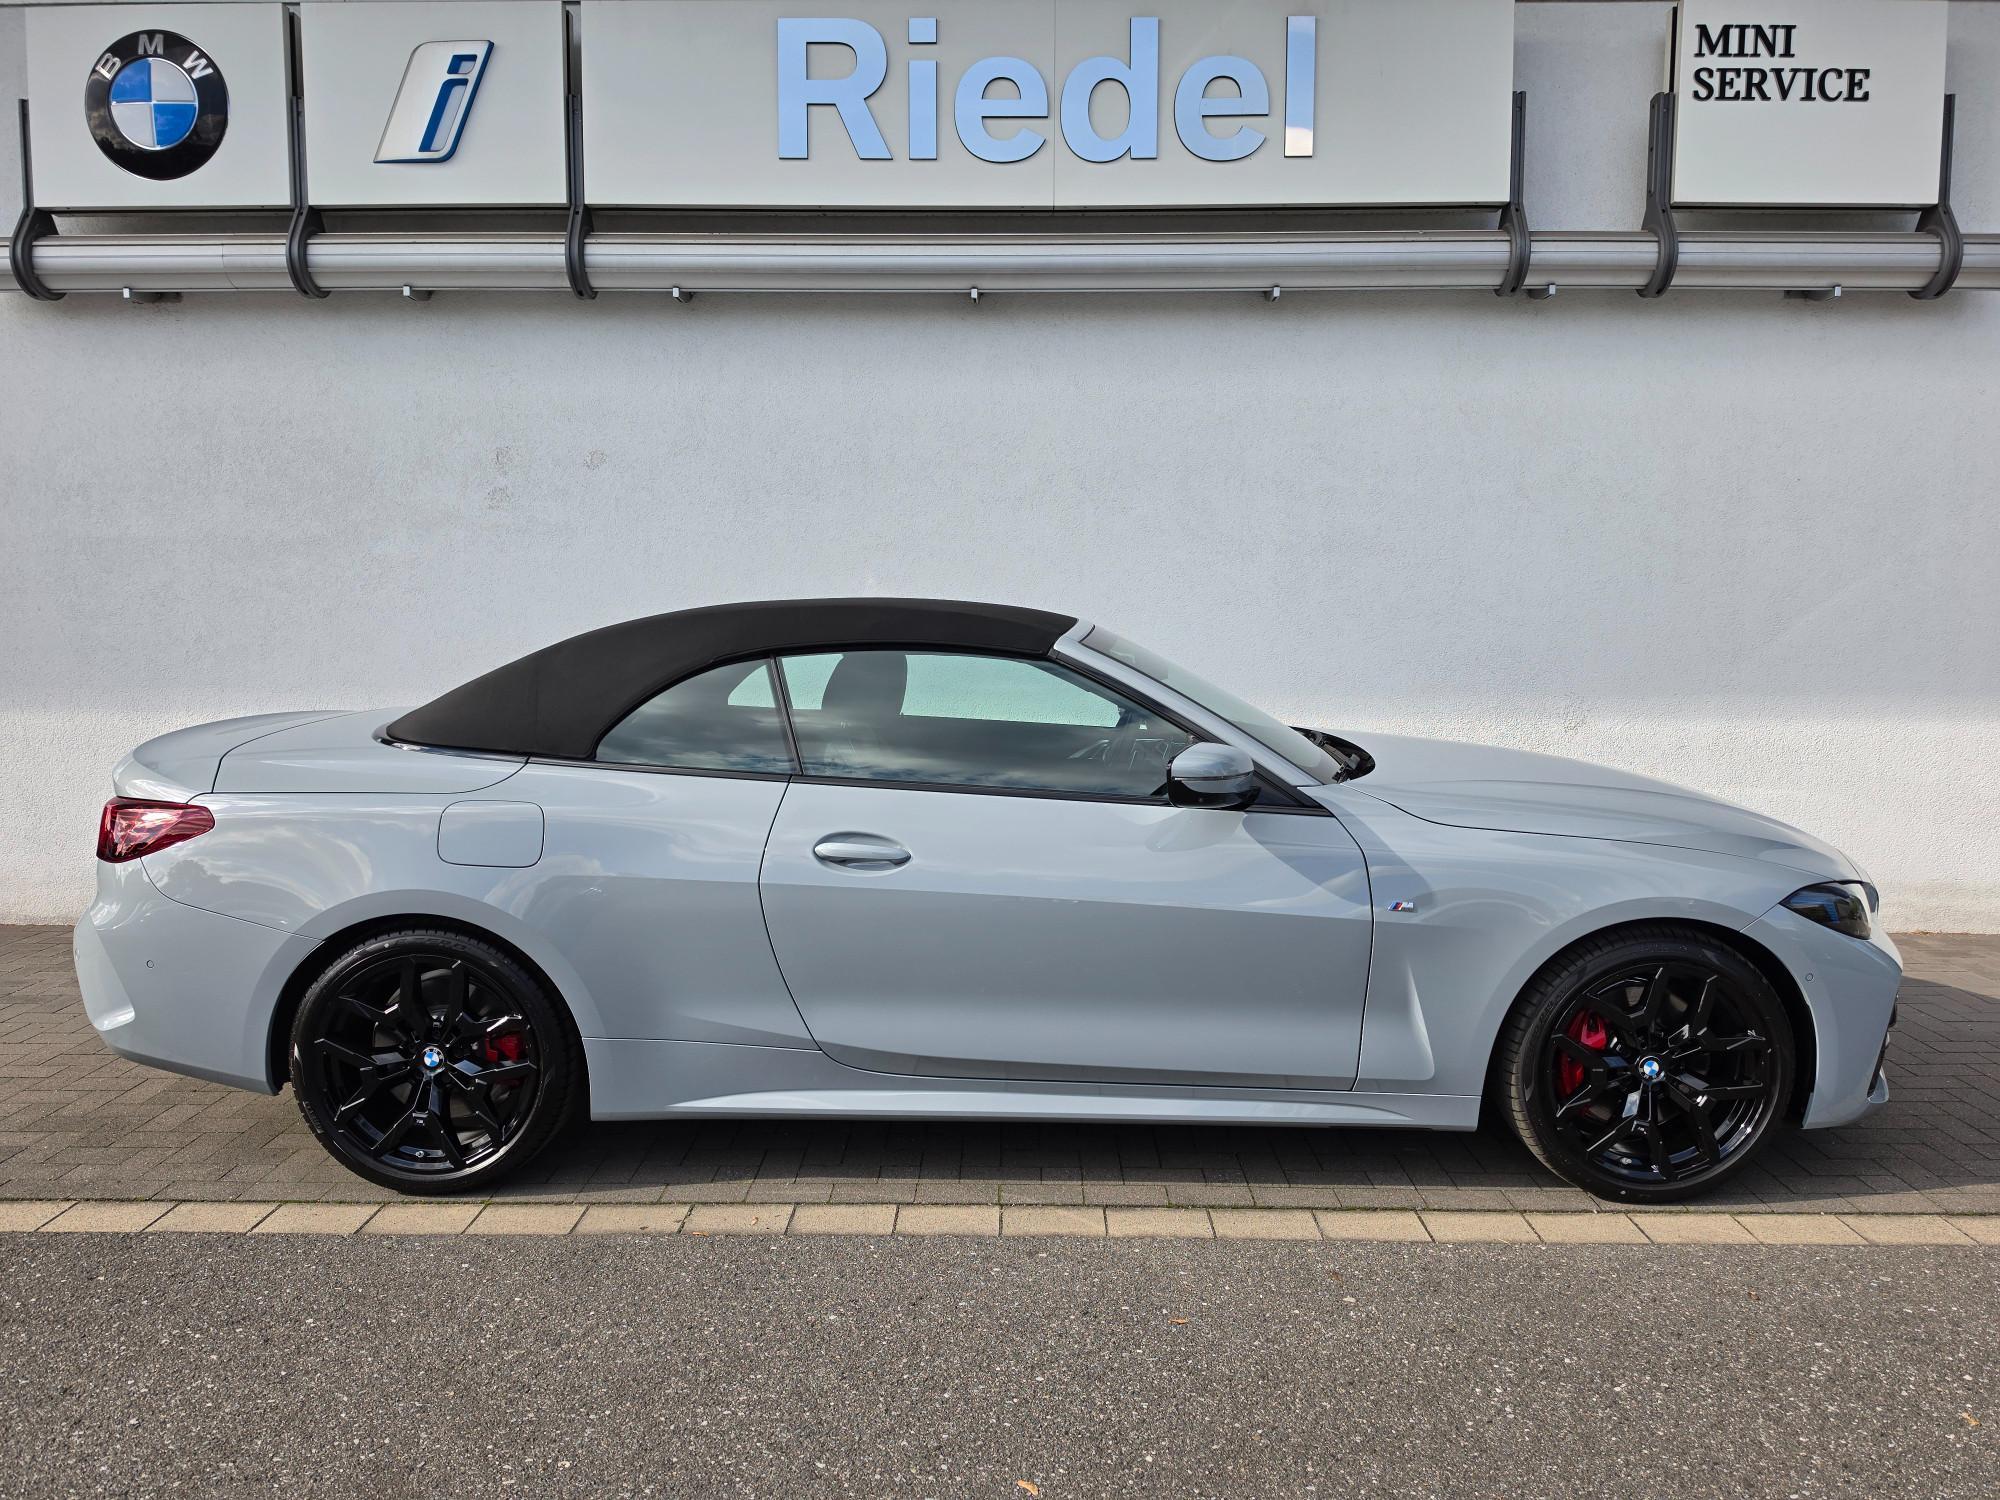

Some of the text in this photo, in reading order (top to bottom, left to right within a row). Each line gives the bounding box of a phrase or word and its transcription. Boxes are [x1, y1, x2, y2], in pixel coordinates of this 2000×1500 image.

[95, 33, 214, 80] BMW
[1694, 24, 1797, 58] MINI
[418, 54, 479, 152] i
[777, 16, 1316, 163] Riedel
[1692, 67, 1870, 102] SERVICE
